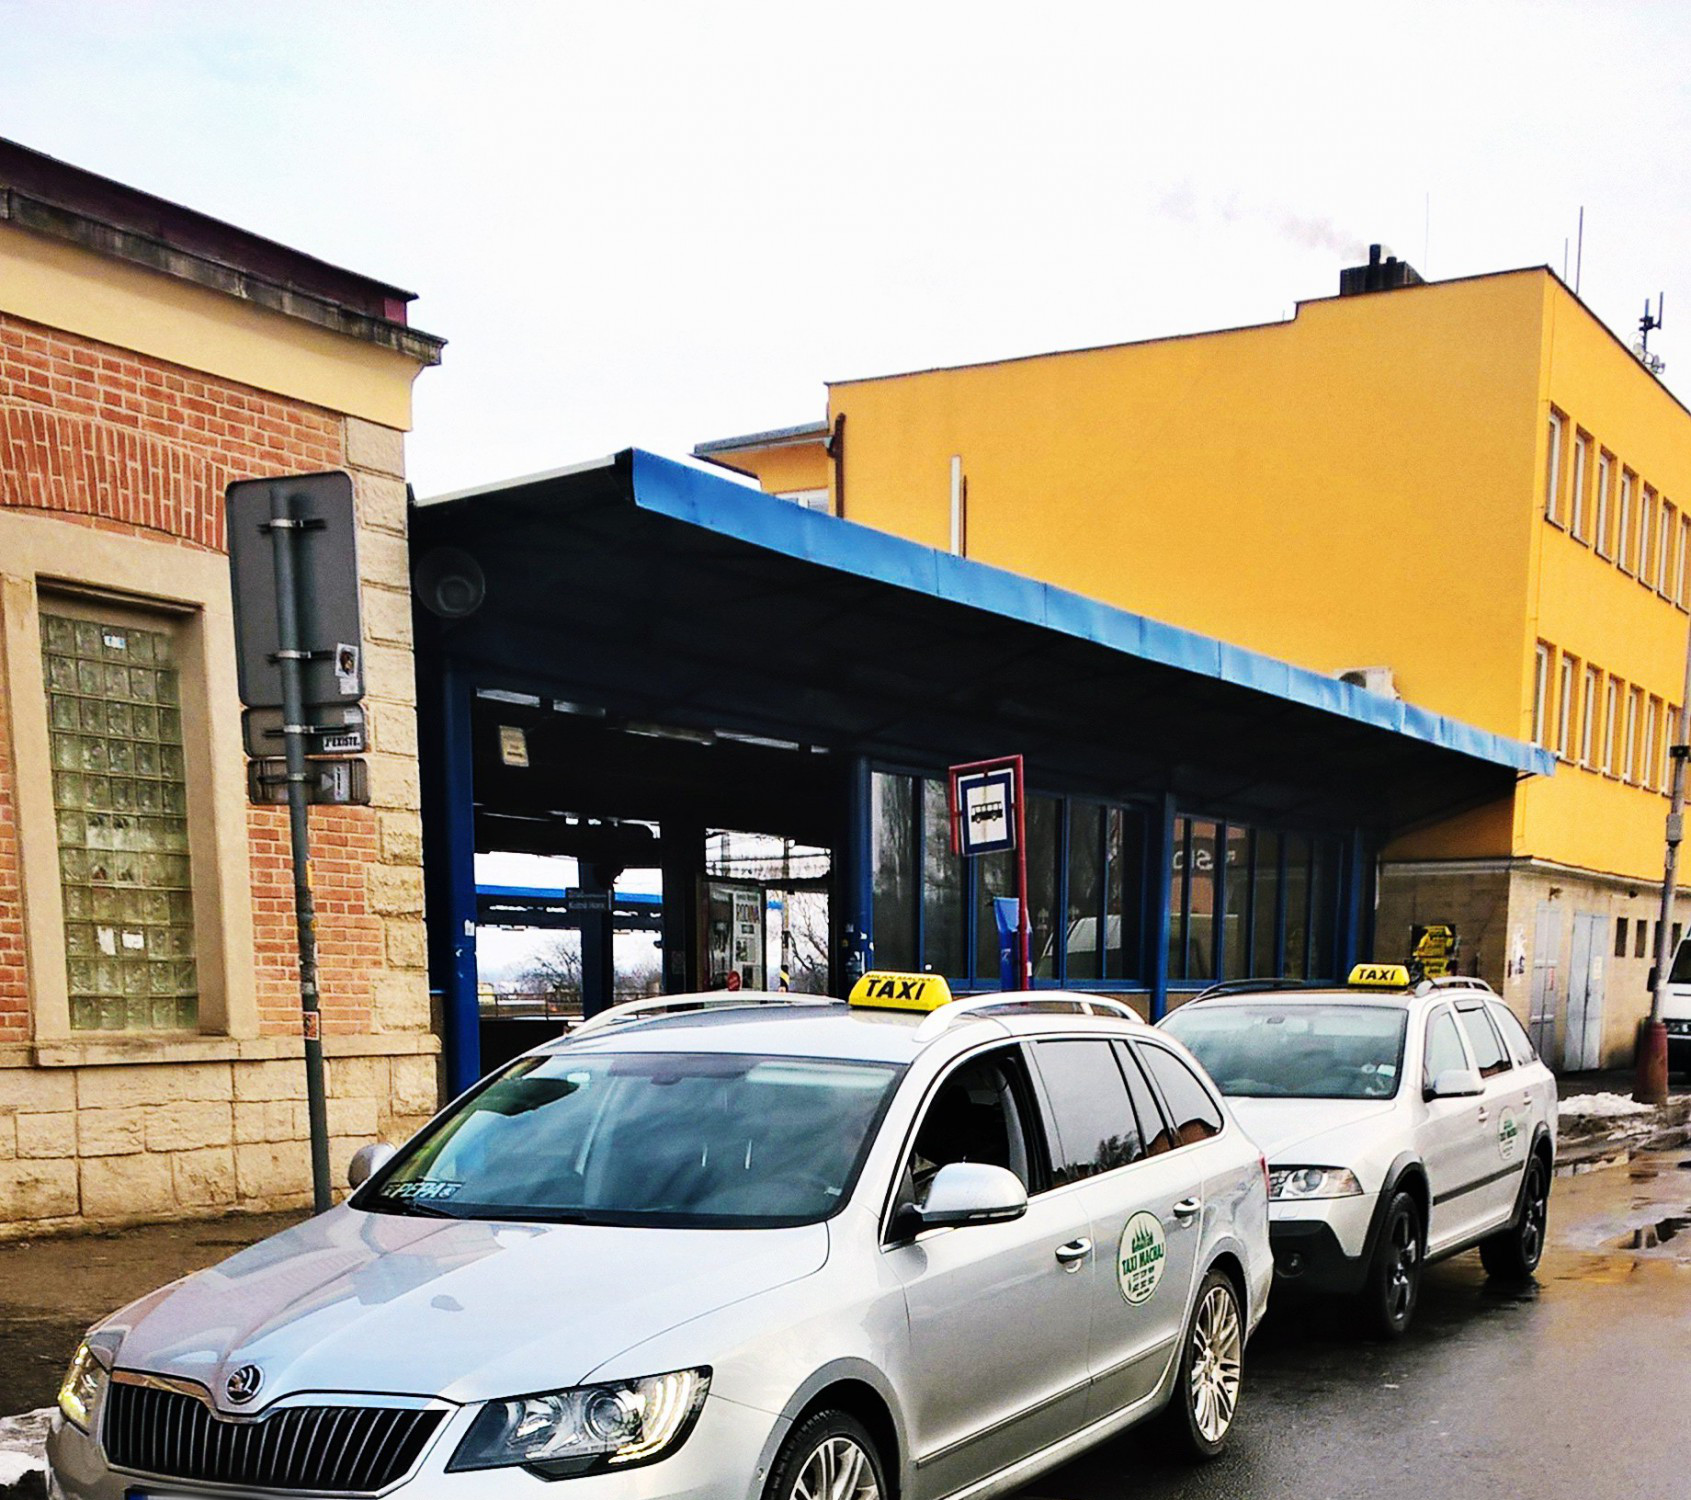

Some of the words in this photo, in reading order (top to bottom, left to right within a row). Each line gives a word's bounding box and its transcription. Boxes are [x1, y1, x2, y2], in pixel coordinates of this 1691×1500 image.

[1359, 968, 1396, 981] TAXI
[866, 979, 926, 1001] TAXI
[389, 1182, 447, 1198] PEPA
[1122, 1255, 1138, 1275] TAXI
